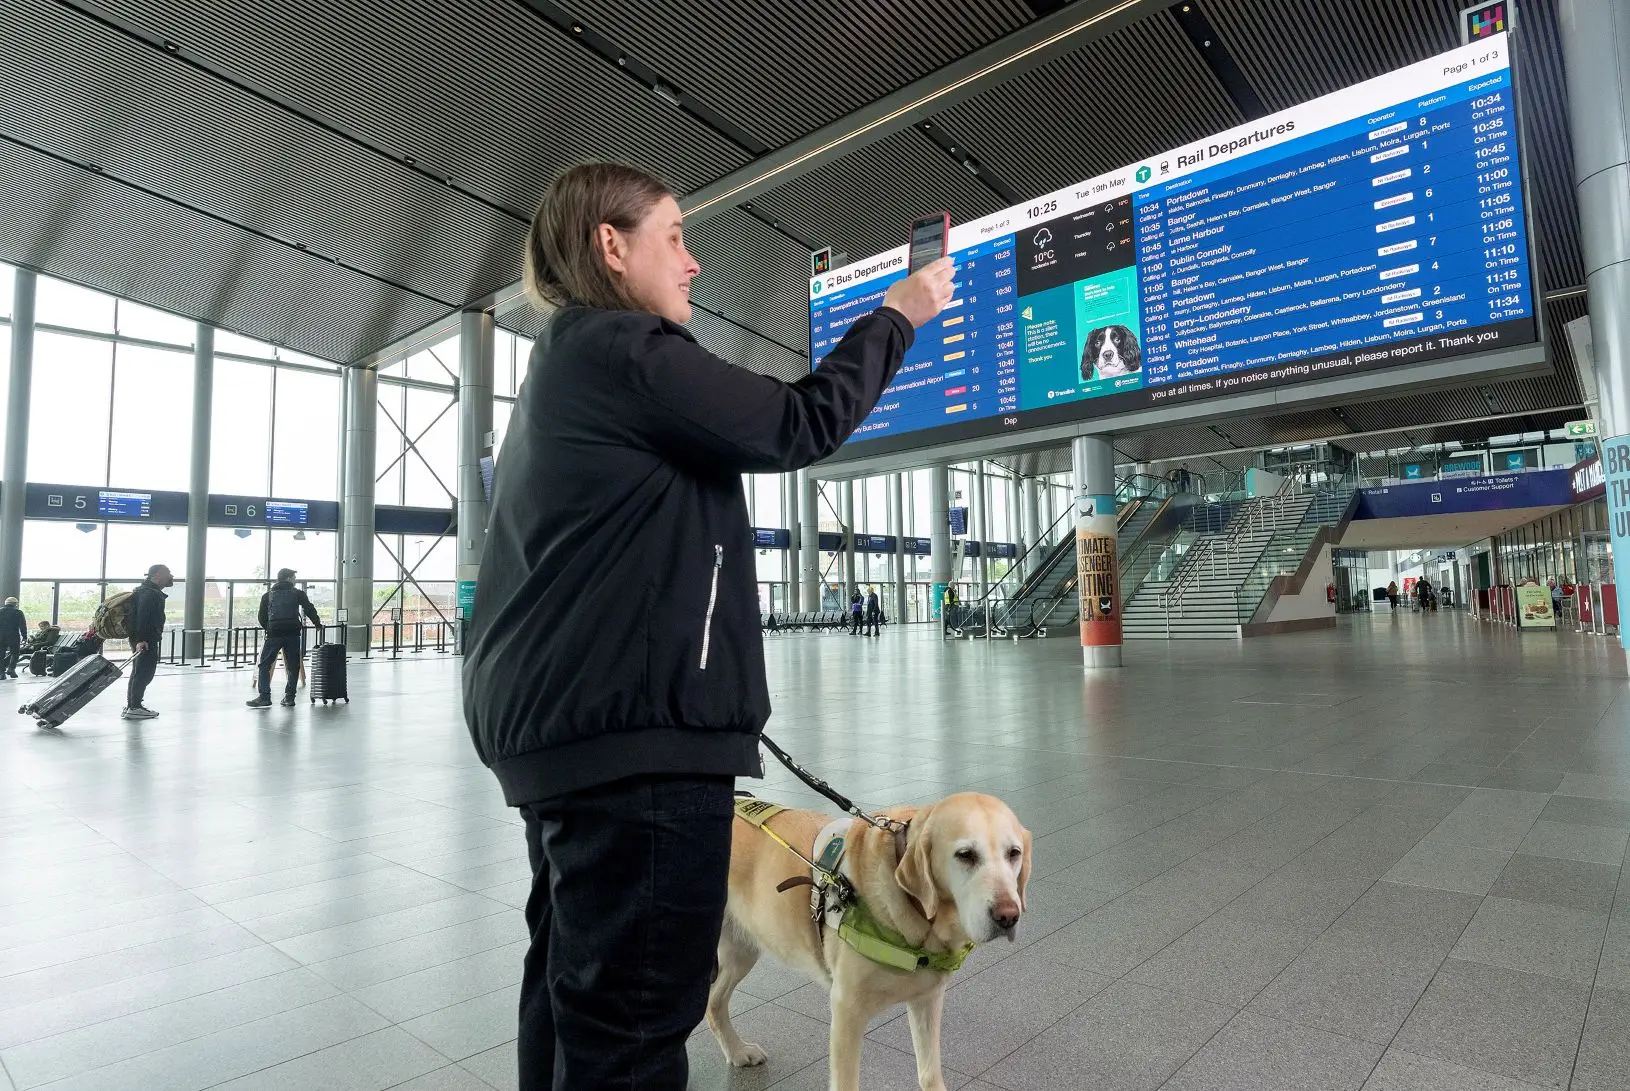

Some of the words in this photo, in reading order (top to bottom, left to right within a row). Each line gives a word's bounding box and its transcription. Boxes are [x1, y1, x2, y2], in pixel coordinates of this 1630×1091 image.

[1443, 63, 1467, 75] Page
[1479, 54, 1488, 62] of
[1468, 75, 1501, 91] Expected
[1418, 95, 1446, 108] Platform
[1470, 93, 1501, 109] 10:34
[1484, 105, 1505, 115] Time
[1367, 111, 1395, 124] Operator
[1419, 116, 1426, 126] 8
[1472, 117, 1503, 133] 10:35
[1487, 130, 1507, 139] Time
[1177, 149, 1203, 168] Rail
[1208, 121, 1294, 157] Departures
[1422, 140, 1427, 148] 1
[1474, 142, 1505, 158] 10:45
[1490, 155, 1509, 164] Time
[1423, 164, 1430, 173] 2
[1477, 168, 1508, 183] 11:00
[1075, 190, 1089, 199] Tue
[1092, 183, 1107, 193] 19th
[1109, 177, 1125, 188] May
[1165, 179, 1192, 190] Destination
[1492, 180, 1512, 189] Time
[1166, 188, 1208, 206] Portadown
[1425, 188, 1432, 197] 6
[1479, 192, 1510, 208] 11:05
[1027, 200, 1056, 218] 10:25
[1139, 202, 1159, 214] 10:34
[1494, 206, 1514, 214] Time
[1167, 212, 1195, 226] Bangor
[1428, 212, 1433, 221] 1
[1140, 222, 1160, 234] 10:35
[1481, 218, 1512, 233] 11:06
[1192, 225, 1224, 239] Harbour
[1496, 231, 1516, 240] Time
[993, 238, 1011, 247] Expected
[1429, 236, 1436, 245] 7
[1141, 242, 1161, 253] 10:45
[1483, 244, 1515, 258] 11:10
[994, 249, 1010, 260] 10:25
[1034, 249, 1054, 262] 10°C
[1169, 254, 1194, 266] Dublin
[1196, 244, 1231, 259] Connolly
[1431, 261, 1439, 269] 4
[1498, 256, 1519, 265] Time
[836, 274, 852, 284] Bus
[854, 256, 902, 278] Departures
[995, 267, 1010, 278] 10:25
[1142, 262, 1162, 273] 11:00
[1171, 274, 1199, 287] Bangor
[1486, 269, 1517, 283] 11:15
[995, 285, 1011, 295] 10:30
[1143, 282, 1163, 294] 11:05
[1433, 285, 1440, 295] 2
[1501, 282, 1521, 290] Time
[1172, 292, 1215, 307] Portadown
[1488, 294, 1519, 308] 11:34
[996, 303, 1012, 313] 10:30
[1144, 303, 1165, 314] 11:06
[1435, 310, 1442, 319] 3
[997, 321, 1013, 331] 10:35
[1199, 342, 1224, 352] Hospital,
[1225, 338, 1248, 347] Botanic,
[1249, 333, 1271, 342] Lanyon
[1308, 321, 1329, 330] Street,
[1330, 313, 1371, 325] Whiteabbey,
[1373, 303, 1420, 317] Jordanstown,
[1421, 293, 1465, 307] Greenisland
[1146, 323, 1166, 334] 11:10
[997, 340, 1014, 349] 10:40
[1174, 333, 1216, 348] Whitehead
[1147, 344, 1167, 354] 11:15
[914, 361, 932, 370] Station
[998, 358, 1014, 367] 10:40
[1151, 390, 1166, 400] you
[1168, 387, 1176, 396] at
[1177, 385, 1186, 394] all
[1188, 382, 1213, 392] times.
[1215, 378, 1221, 387] If
[1222, 377, 1238, 388] you
[1241, 372, 1268, 383] notice
[1270, 365, 1309, 378] anything
[1311, 355, 1352, 370] unusual,
[1354, 351, 1388, 365] please
[1391, 343, 1423, 356] report
[1425, 341, 1436, 350] it.
[1438, 334, 1474, 348] Thank
[1476, 331, 1498, 343] you
[1175, 356, 1218, 369] Portadown
[1148, 364, 1168, 374] 11:34
[895, 378, 926, 391] International
[926, 375, 943, 384] Airport
[999, 376, 1015, 386] 10:40
[999, 395, 1016, 404] 10:45
[883, 402, 899, 411] Airport
[872, 421, 889, 429] Station
[1444, 461, 1480, 472] BREWDOG
[74, 496, 86, 508] 5
[246, 505, 256, 517] 6
